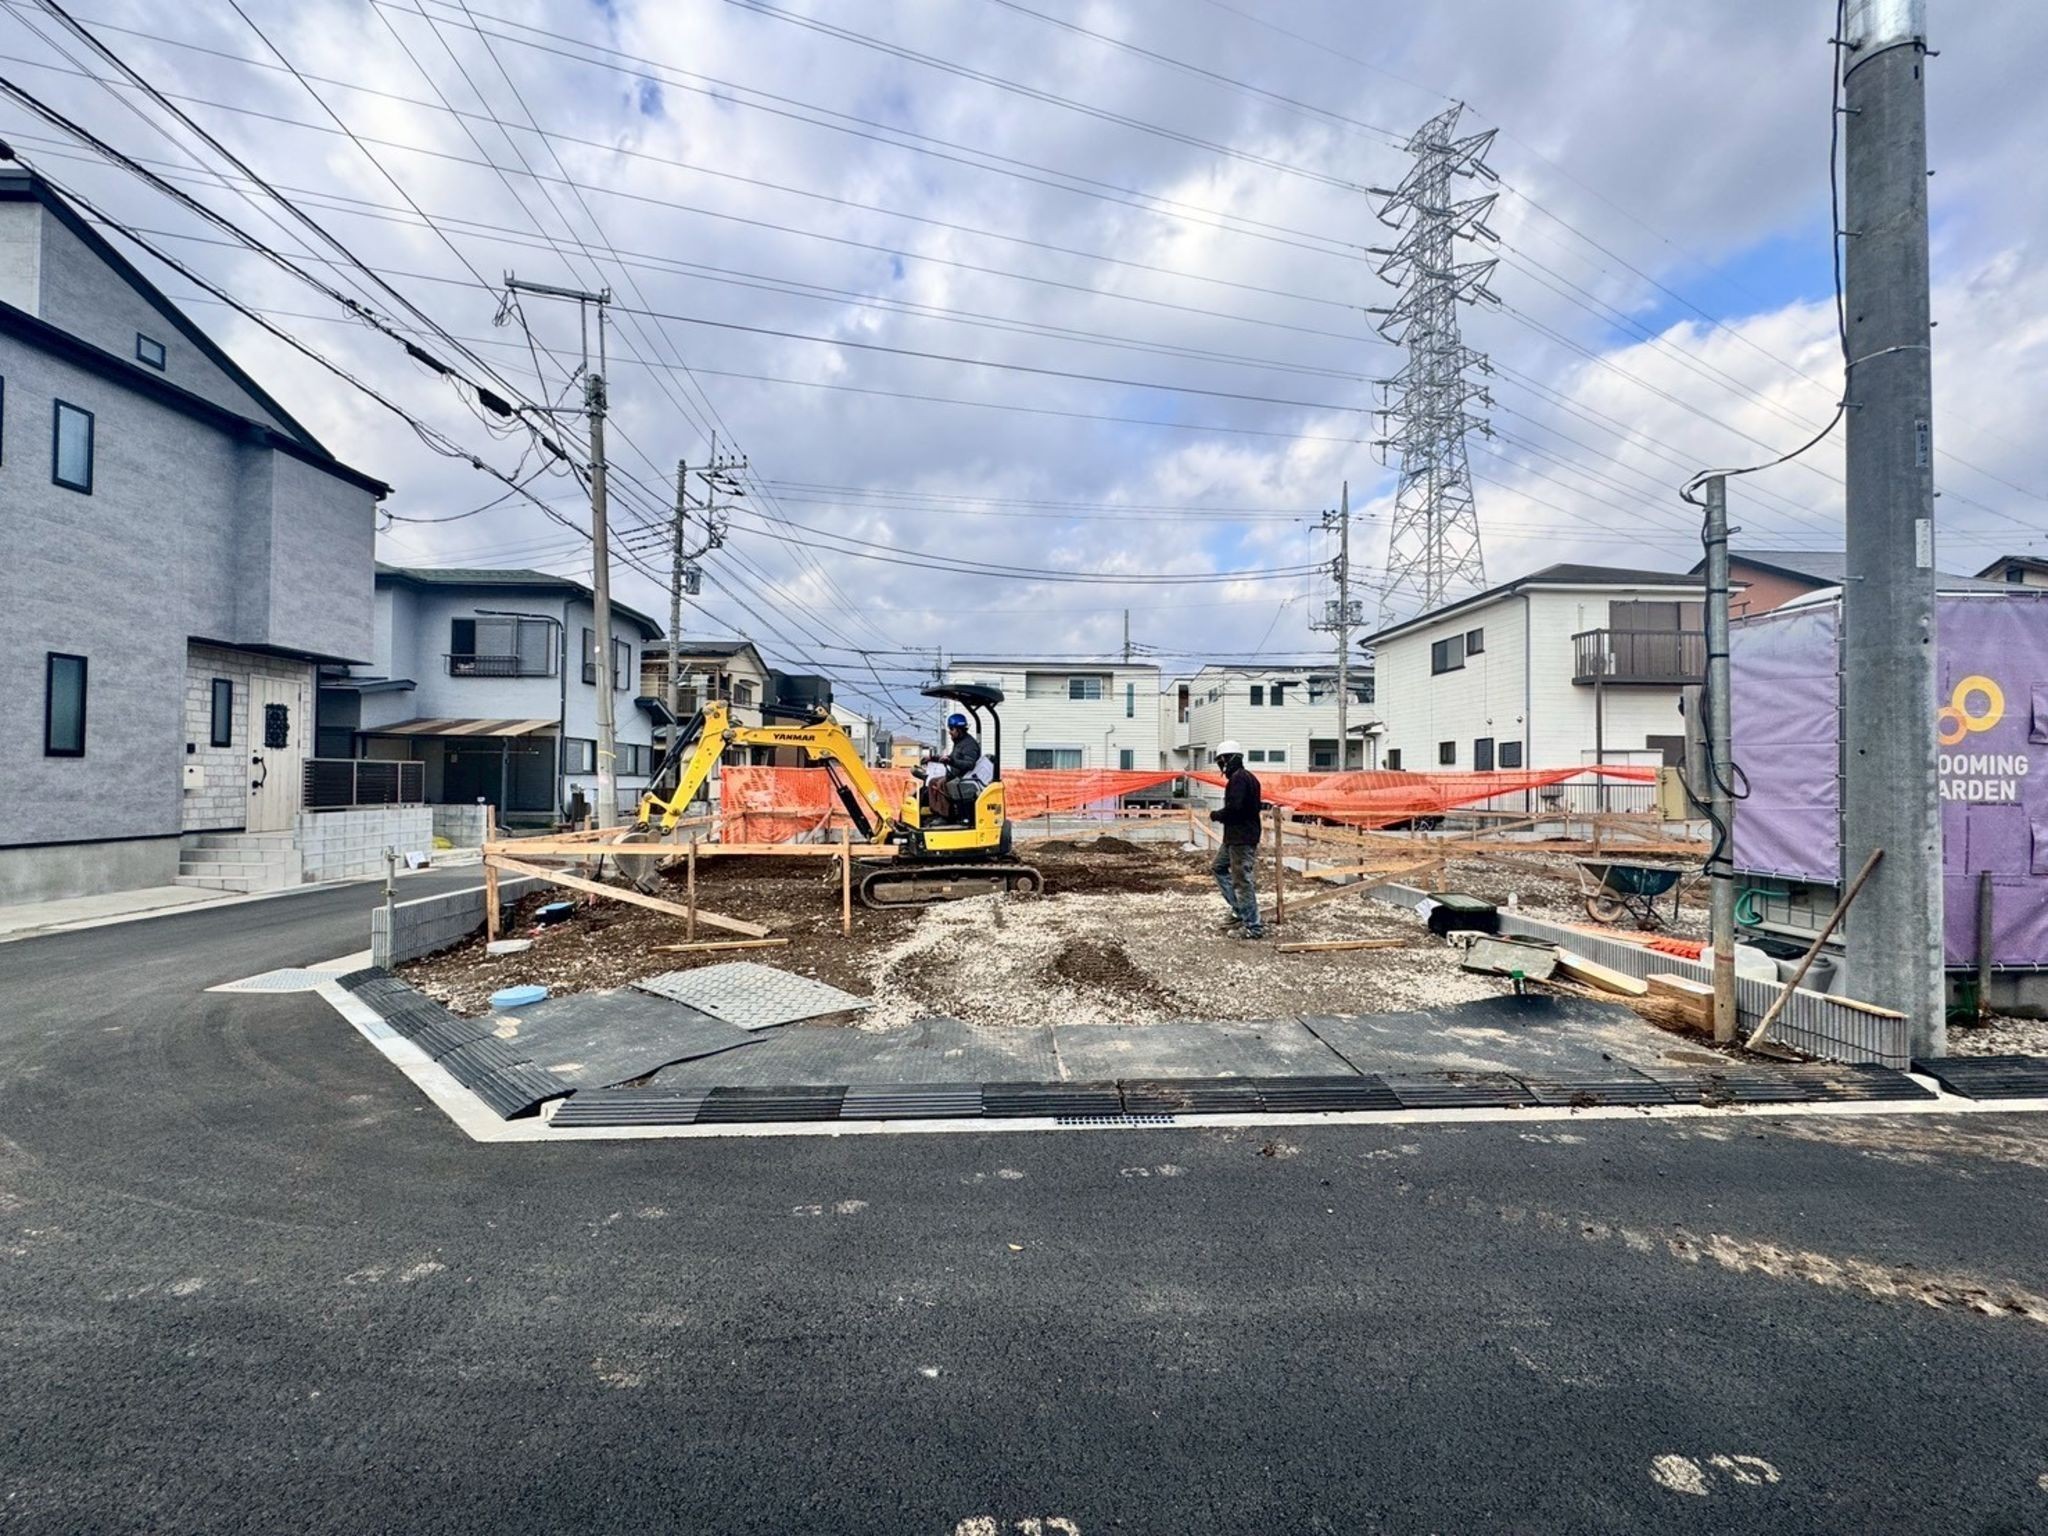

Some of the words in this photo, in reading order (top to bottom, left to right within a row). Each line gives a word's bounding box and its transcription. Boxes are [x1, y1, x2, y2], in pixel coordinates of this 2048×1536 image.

[773, 733, 816, 741] YANMAR
[1938, 754, 2029, 775] OOMING
[1939, 780, 2016, 800] ARDEN
